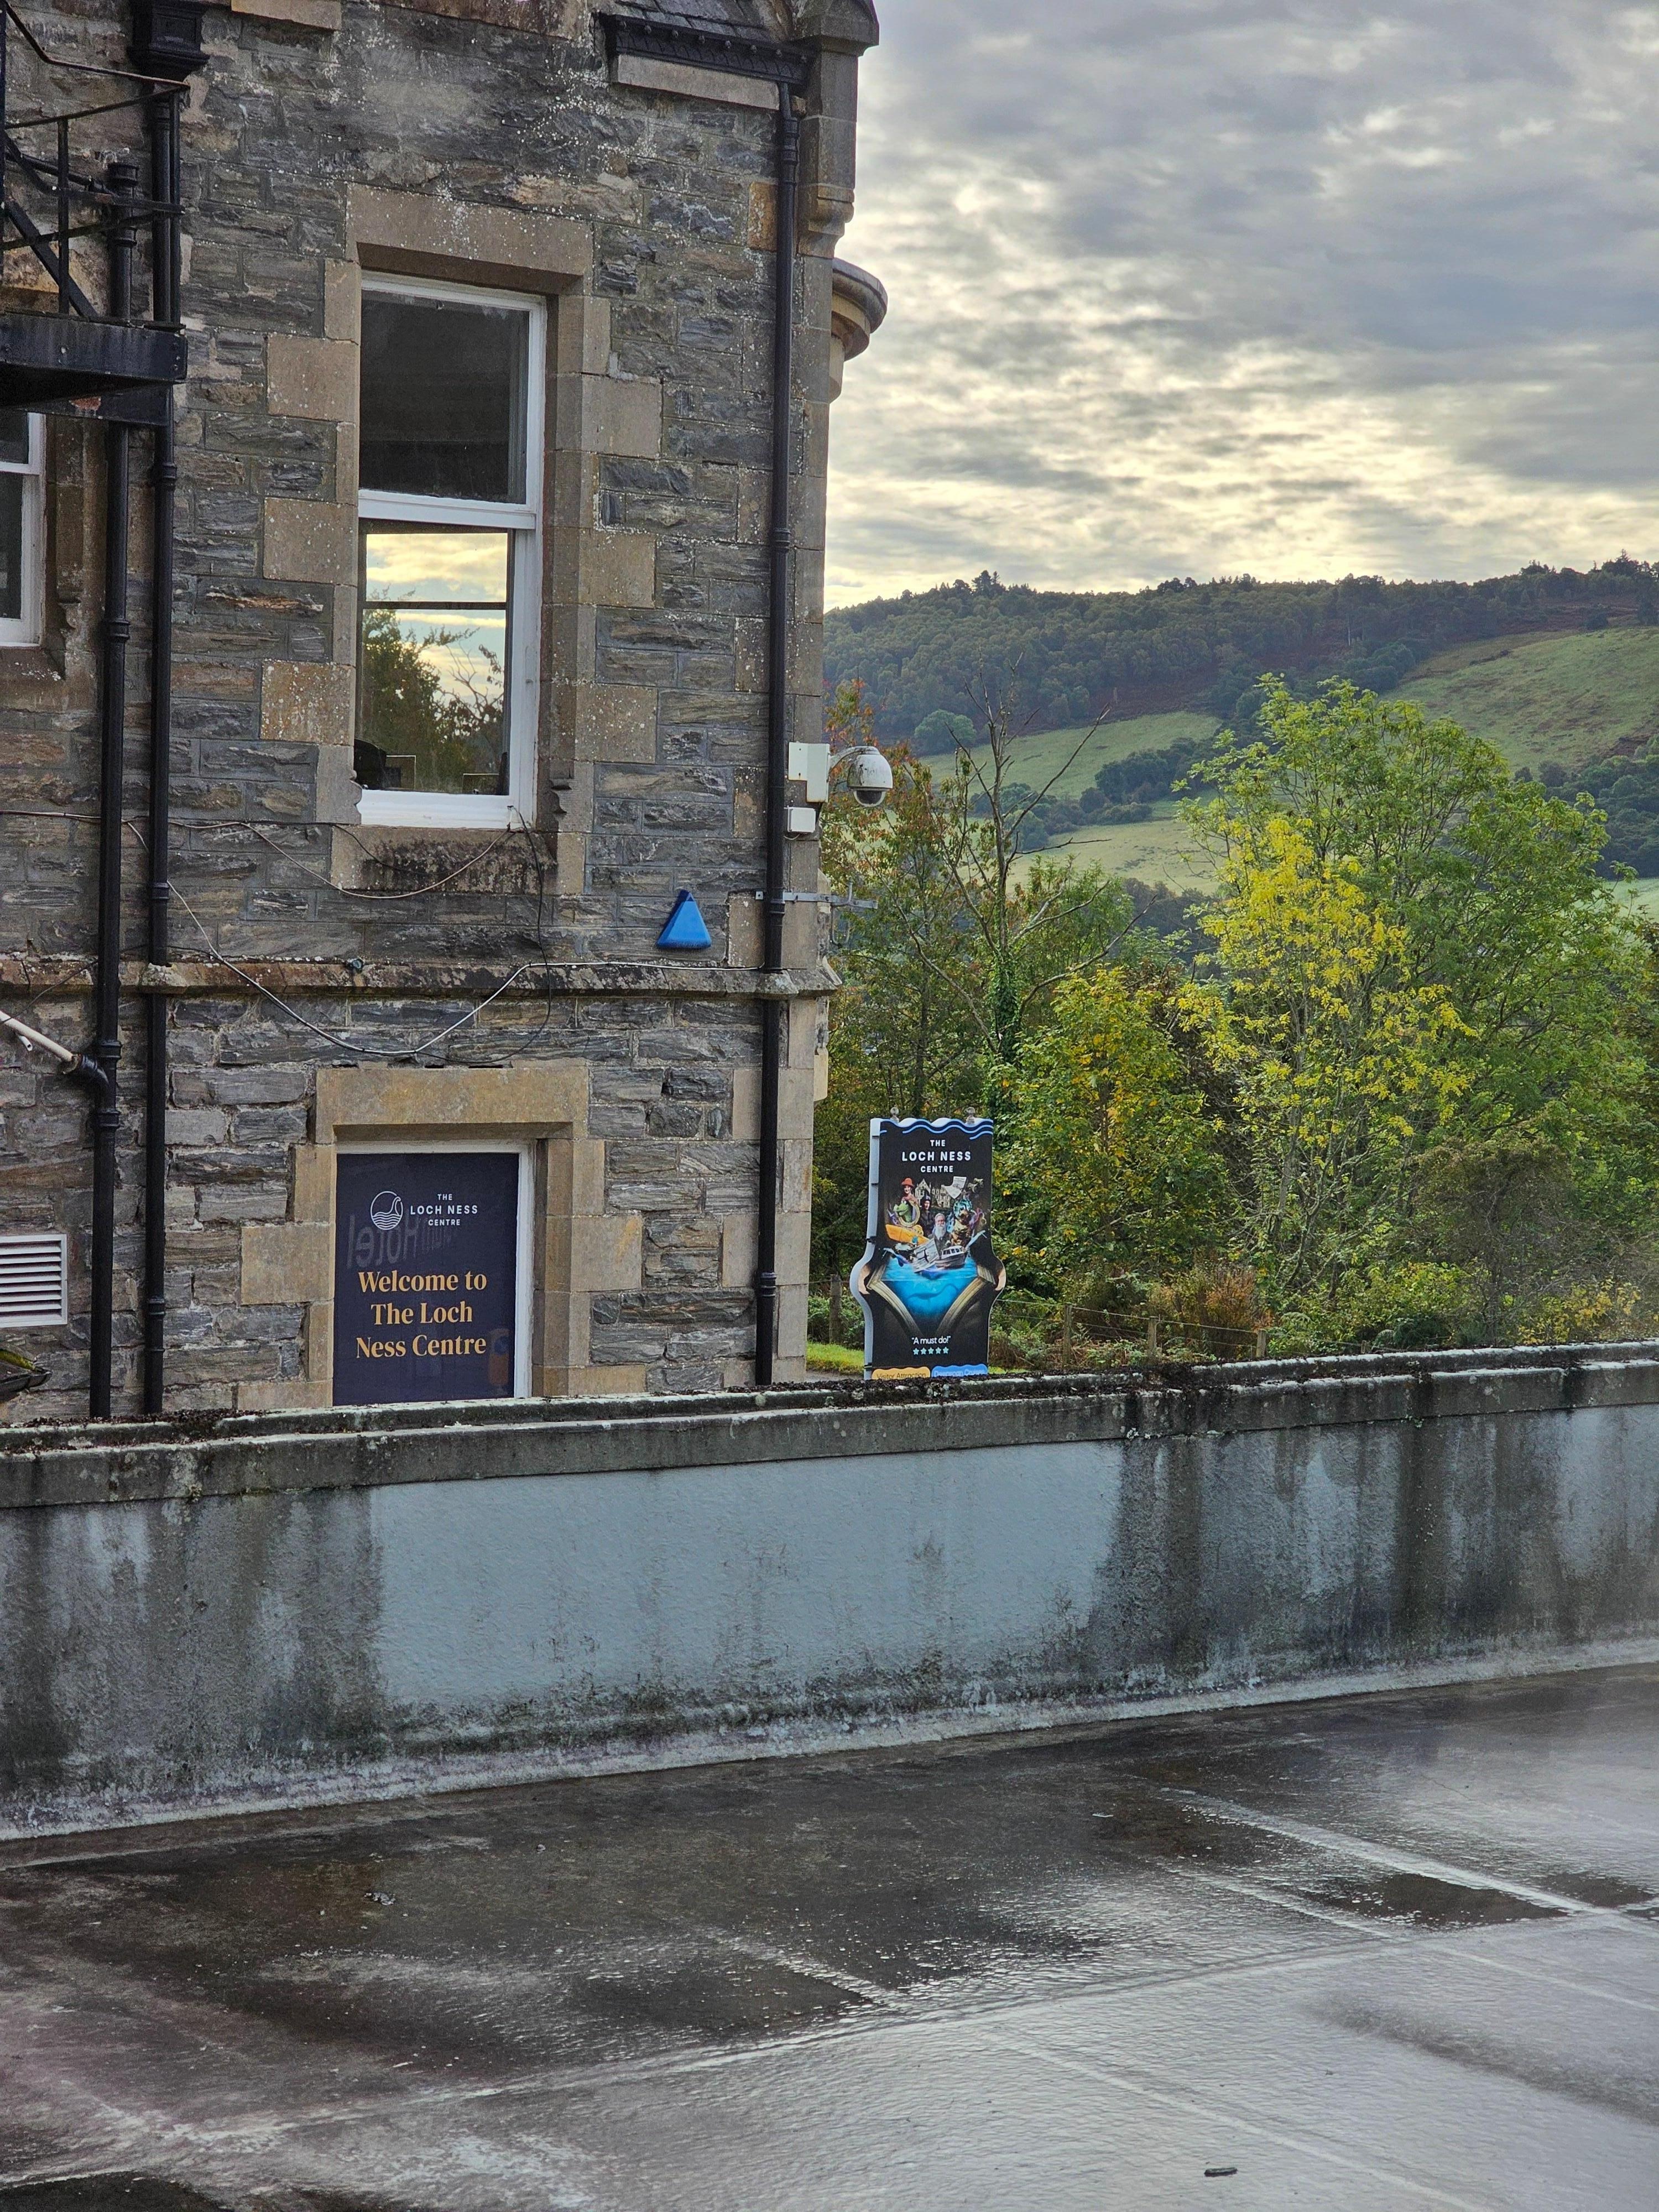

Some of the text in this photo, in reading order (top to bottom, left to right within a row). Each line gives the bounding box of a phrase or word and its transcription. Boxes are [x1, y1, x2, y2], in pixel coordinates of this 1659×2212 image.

[902, 1151, 971, 1161] LOCH NESS
[410, 1205, 478, 1215] LOCH NESS
[358, 1270, 487, 1293] Welcome to
[371, 1301, 472, 1325] The Loch
[356, 1334, 487, 1358] Ness Centre
